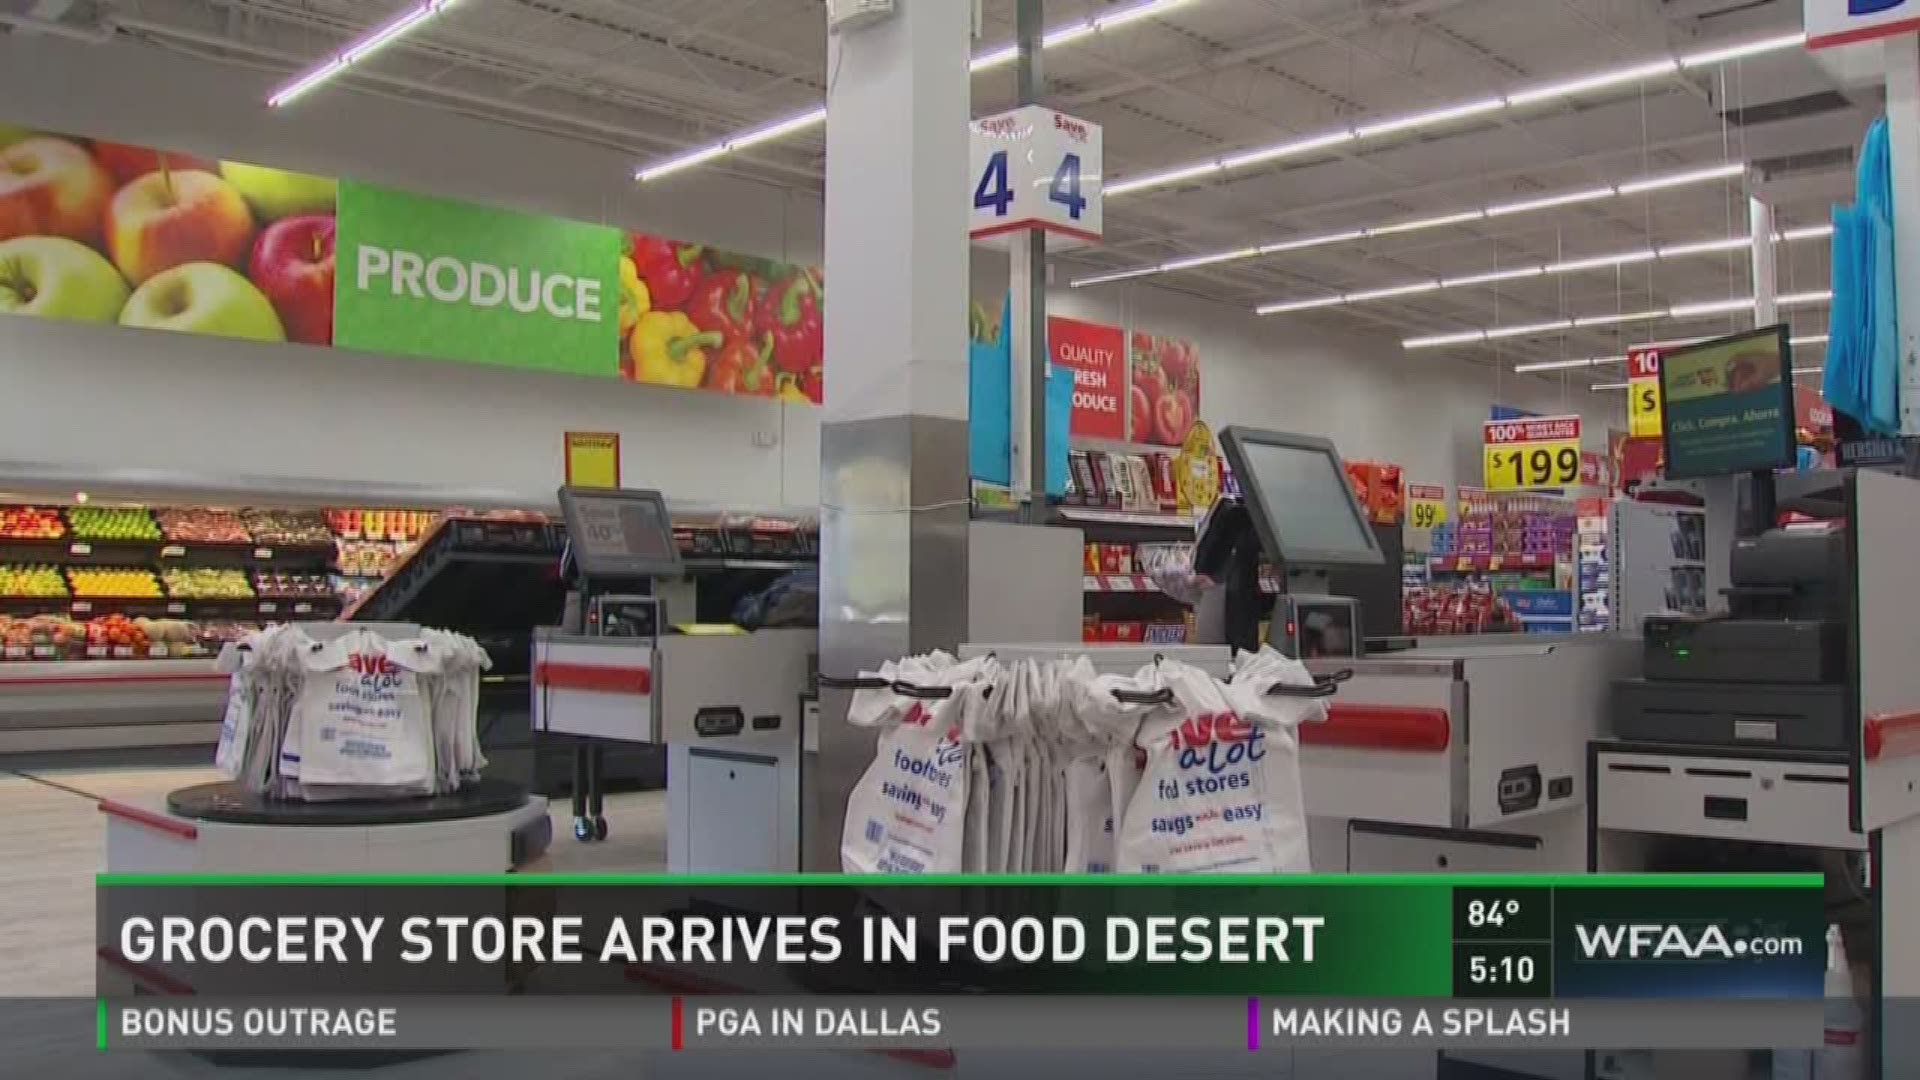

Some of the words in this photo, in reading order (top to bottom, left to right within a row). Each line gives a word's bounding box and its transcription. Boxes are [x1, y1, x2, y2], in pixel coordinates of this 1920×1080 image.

[974, 150, 1014, 216] 4
[1049, 153, 1086, 220] 4
[357, 244, 602, 322] PRODUCE
[1060, 343, 1114, 366] QUALITY
[1074, 370, 1107, 388] RESH
[1073, 391, 1117, 412] ODUCE
[1185, 772, 1250, 796] stores
[1223, 803, 1262, 822] easy
